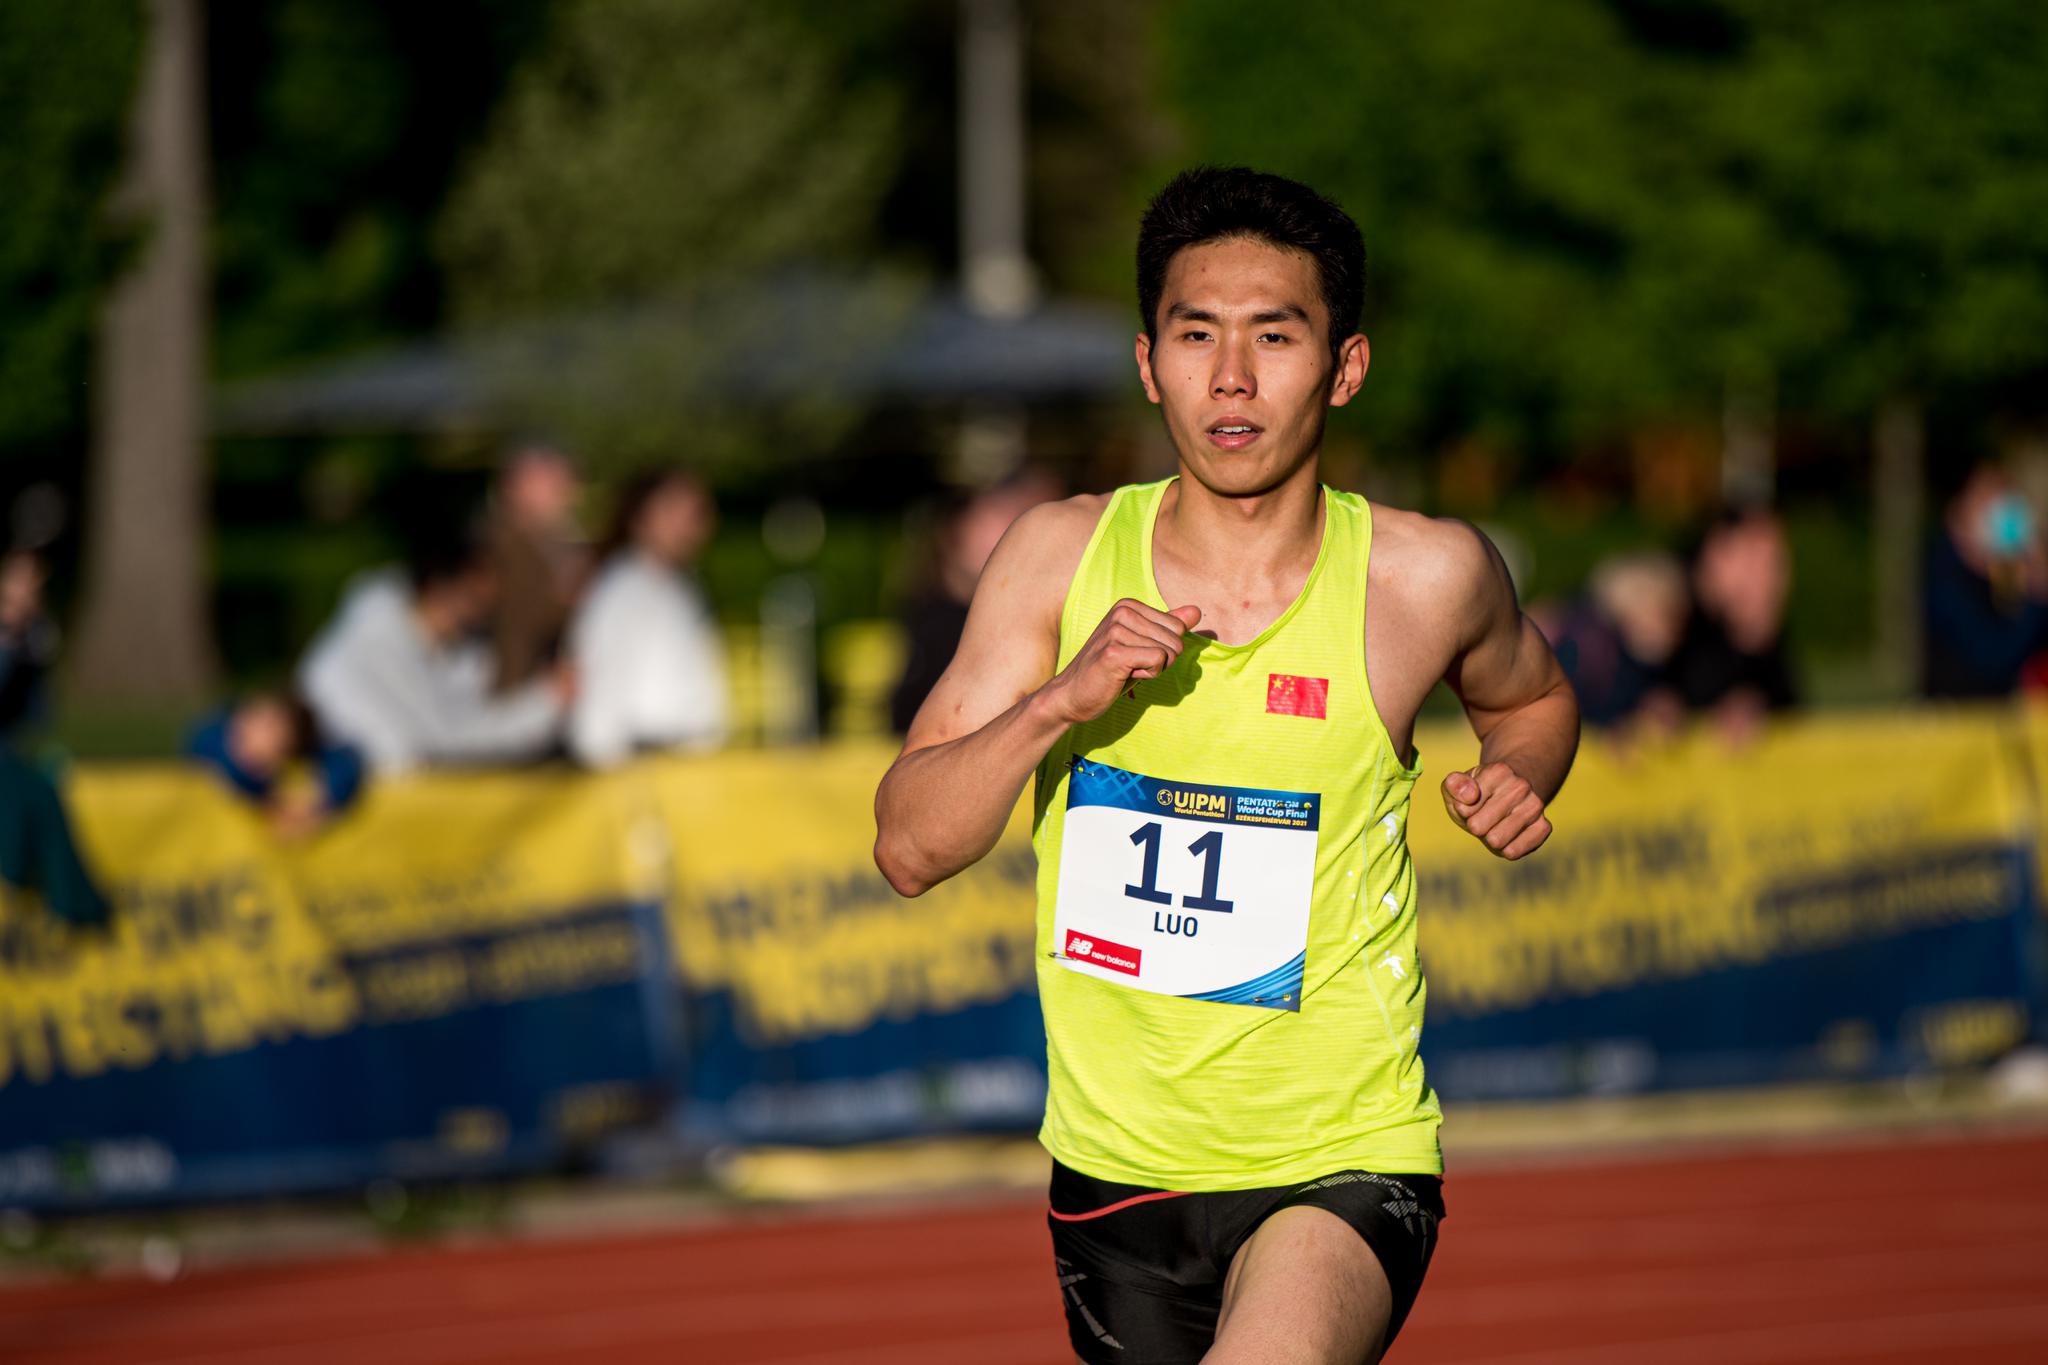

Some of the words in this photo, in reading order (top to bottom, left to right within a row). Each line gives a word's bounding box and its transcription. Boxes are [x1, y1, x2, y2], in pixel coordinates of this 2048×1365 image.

[1174, 791, 1226, 813] UIPM
[1237, 796, 1299, 808] PENTATHON
[1174, 807, 1192, 815] World
[1193, 809, 1225, 818] Pentathlon
[1236, 805, 1264, 815] World
[1266, 807, 1284, 818] Cup
[1286, 809, 1308, 819] Final
[1292, 819, 1307, 827] 2021
[1125, 822, 1234, 913] 11
[1154, 911, 1199, 937] LUO
[1091, 951, 1106, 961] new
[1106, 953, 1136, 969] balance
